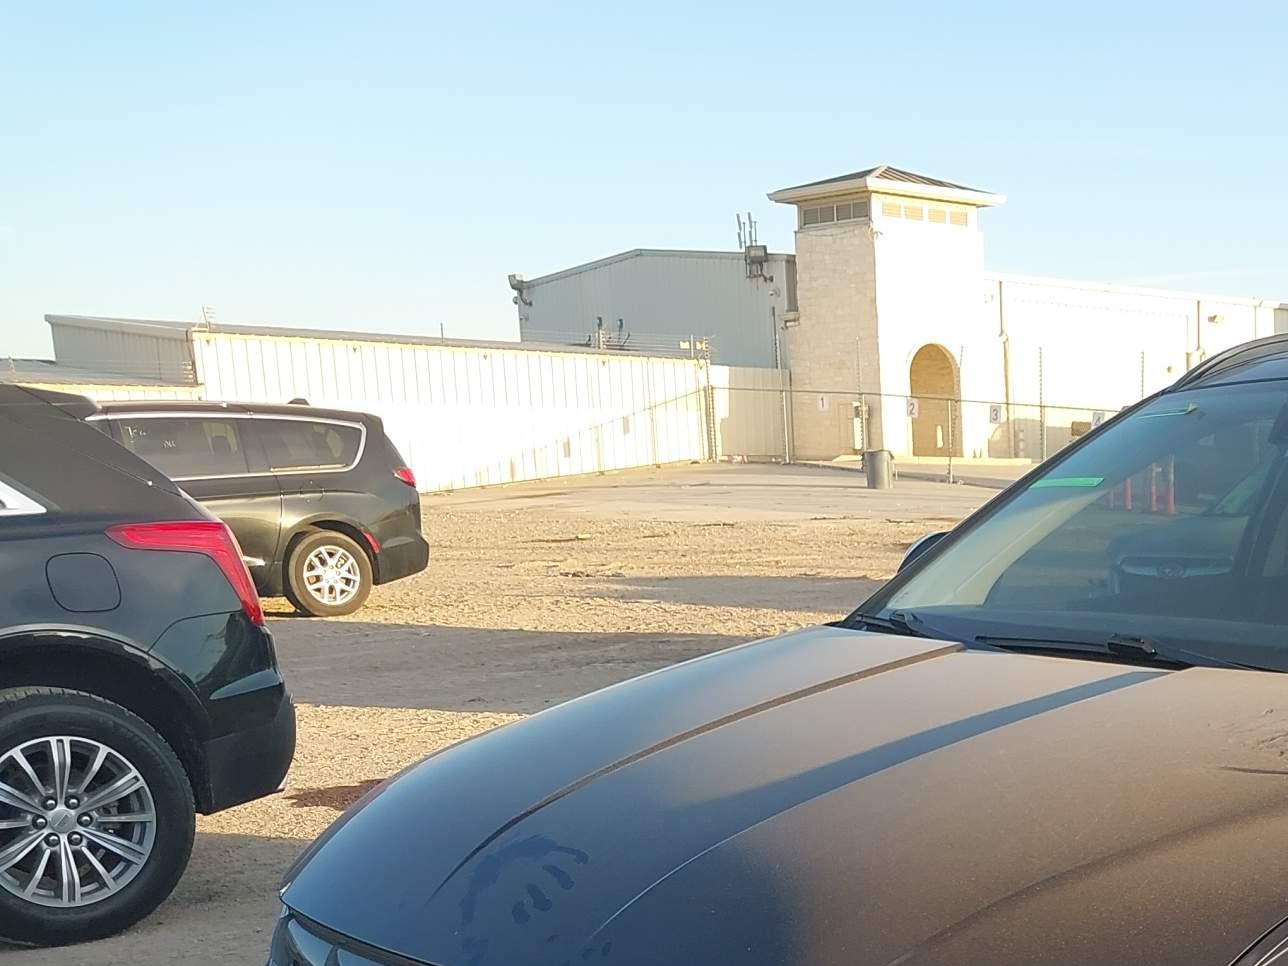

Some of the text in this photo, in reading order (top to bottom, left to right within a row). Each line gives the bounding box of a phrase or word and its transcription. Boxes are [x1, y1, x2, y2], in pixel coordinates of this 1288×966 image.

[820, 397, 825, 408] 1
[908, 402, 916, 415] 2
[992, 408, 999, 421] 3
